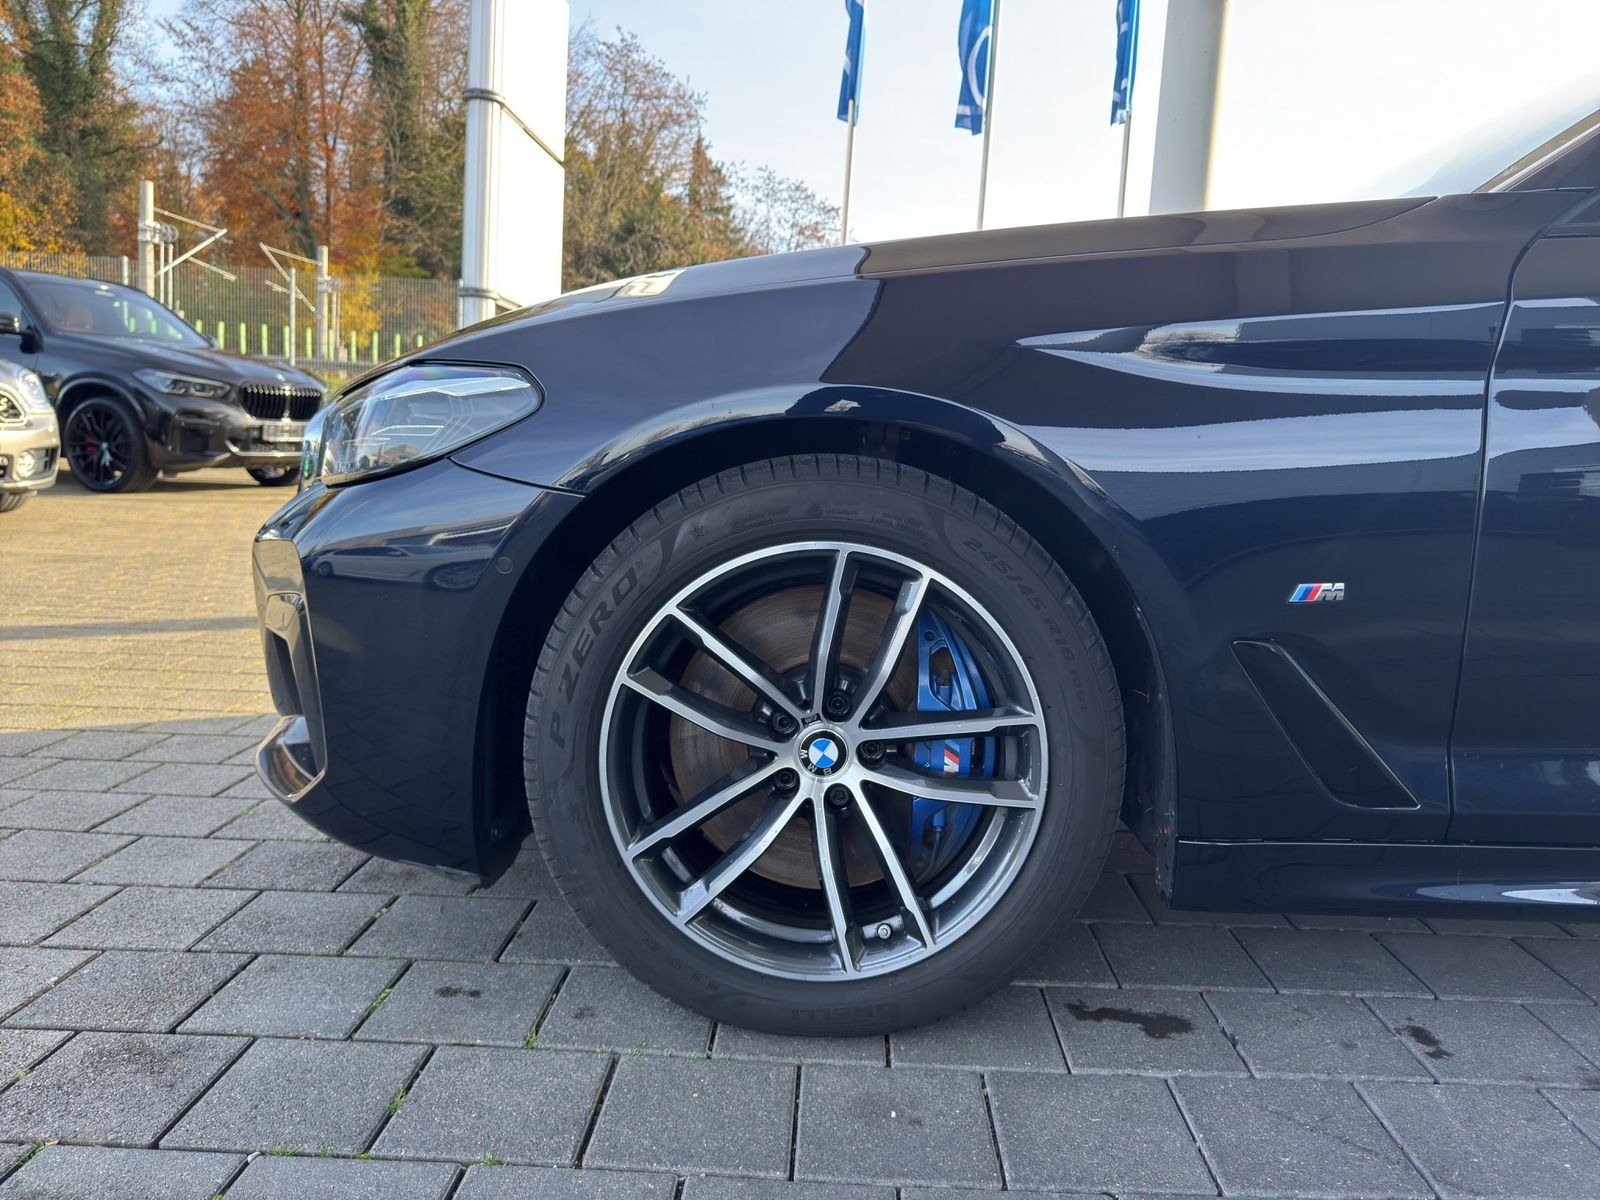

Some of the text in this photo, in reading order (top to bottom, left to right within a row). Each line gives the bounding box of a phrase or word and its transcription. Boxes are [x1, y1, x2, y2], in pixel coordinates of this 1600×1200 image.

[550, 567, 638, 749] P ZERO
[800, 748, 832, 775] BMW
